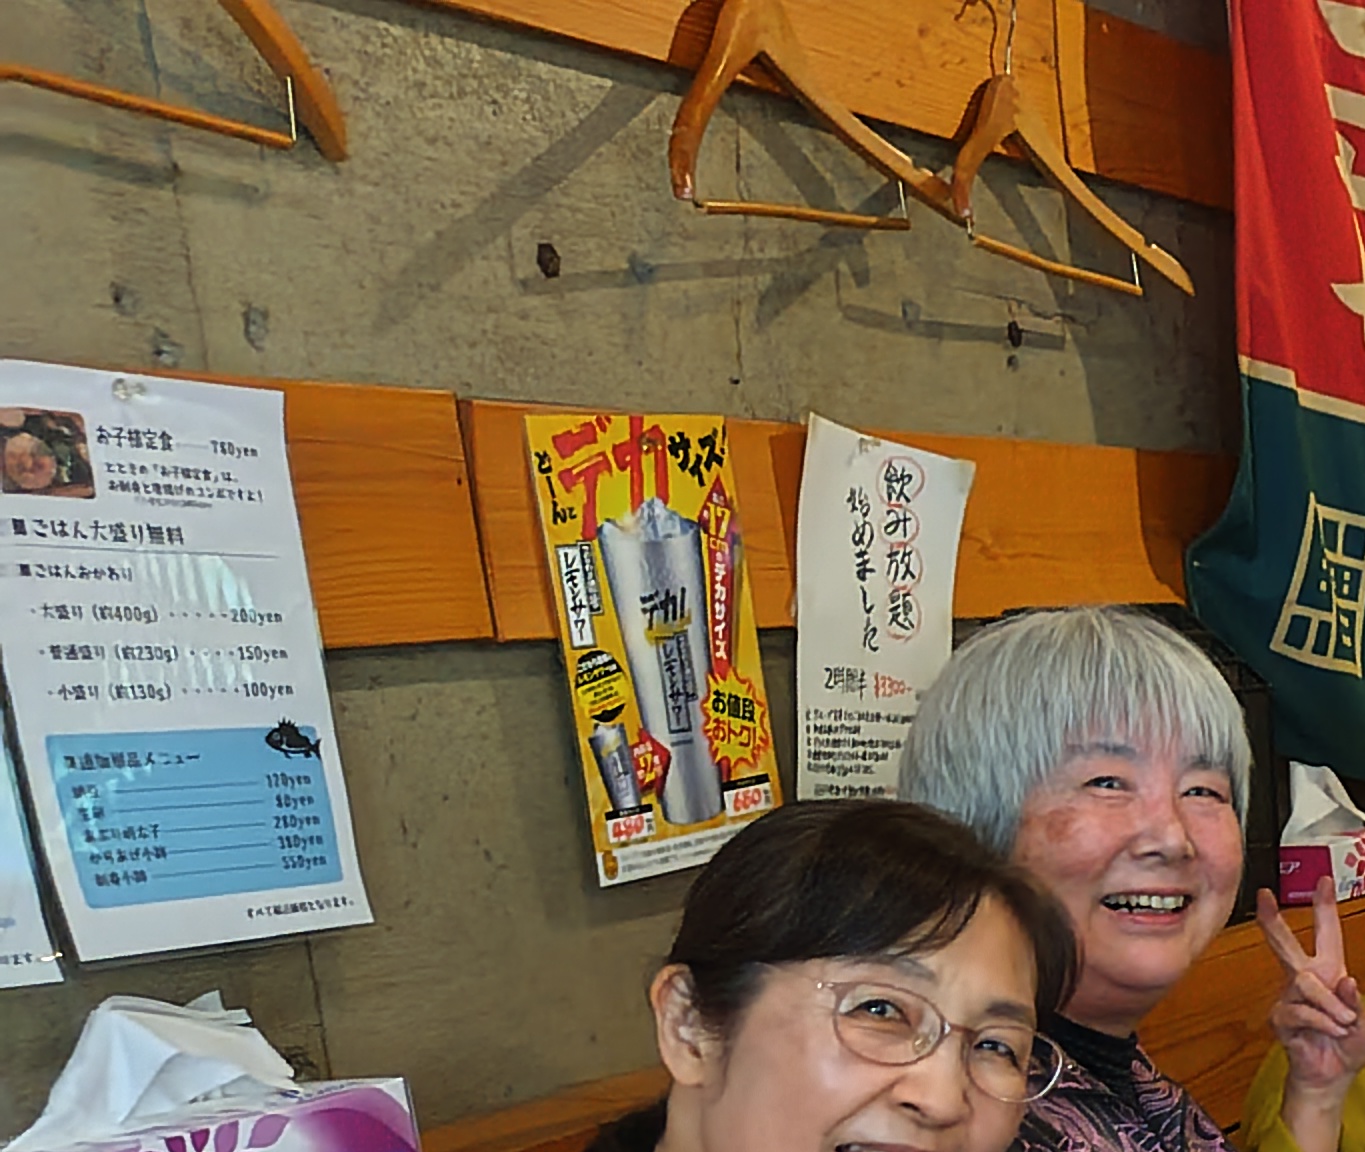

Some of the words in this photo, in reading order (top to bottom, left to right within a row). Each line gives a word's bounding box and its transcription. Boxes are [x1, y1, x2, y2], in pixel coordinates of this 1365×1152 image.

[96, 424, 174, 452] お子様定食
[668, 424, 729, 488] サイズ!
[533, 450, 577, 526] どーんと
[551, 414, 671, 541] デカ
[845, 485, 880, 653] 始めました
[883, 459, 917, 632] 飲み放題
[231, 607, 283, 627] 200yen
[562, 551, 587, 644] レモンサワー
[238, 645, 289, 663] 150yen
[243, 682, 295, 701] 100yen
[710, 689, 757, 724] お値段
